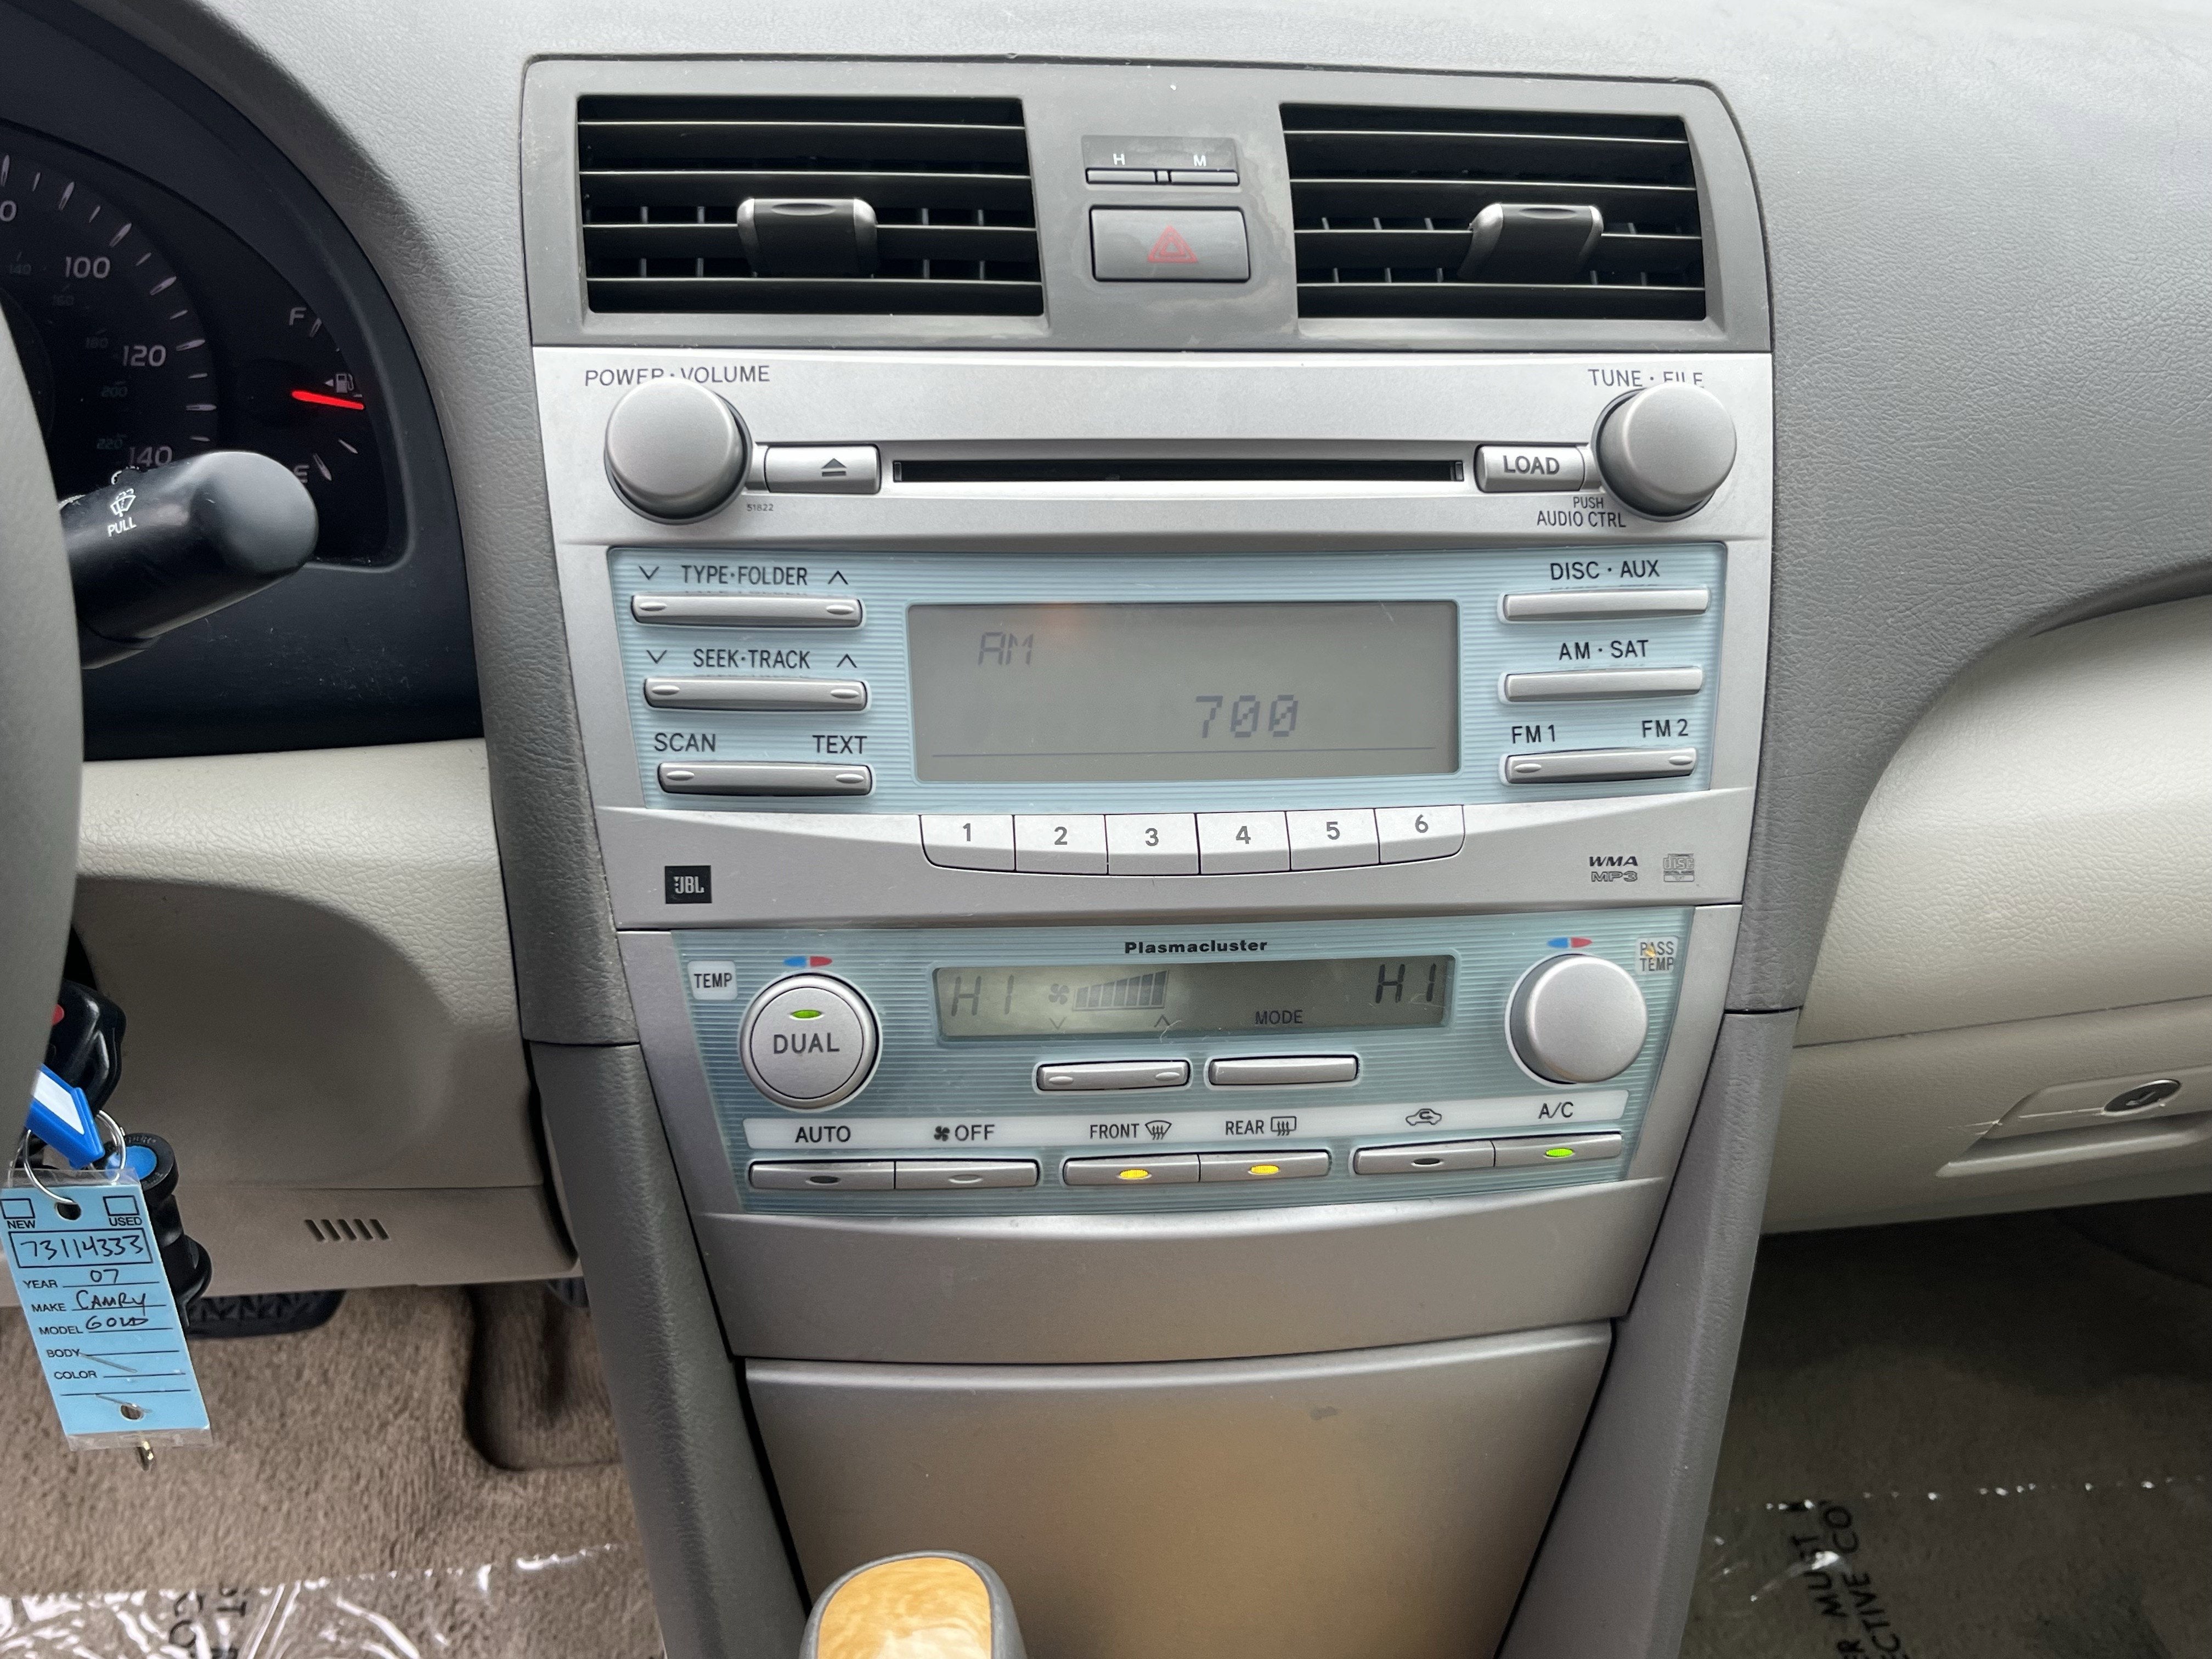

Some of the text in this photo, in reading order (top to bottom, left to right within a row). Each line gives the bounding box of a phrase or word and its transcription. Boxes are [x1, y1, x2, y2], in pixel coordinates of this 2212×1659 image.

[1113, 154, 1125, 165] H
[1193, 154, 1206, 166] M
[65, 256, 110, 278] 100
[289, 307, 307, 325] F
[122, 345, 167, 366] 120
[585, 365, 770, 386] POWER VOLUME
[1587, 369, 1643, 387] TUNE
[128, 446, 173, 467] 140
[1503, 454, 1560, 475] LOAD
[746, 503, 774, 512] 51822
[1572, 496, 1604, 509] PUSH
[108, 517, 137, 537] PULL
[1537, 511, 1627, 528] AUDIO CTRL
[1550, 560, 1661, 580] DISC AUX
[977, 631, 1035, 667] AM
[1558, 639, 1649, 661] AM SAT
[1194, 694, 1299, 738] 700
[654, 732, 716, 753] SCAN
[812, 734, 868, 754] TEXT
[963, 822, 972, 843] 1
[1326, 820, 1341, 840] 5
[1414, 814, 1429, 833] 6
[1053, 826, 1069, 846] 2
[1145, 827, 1160, 847] 3
[1235, 825, 1252, 845] 4
[1589, 856, 1638, 867] WMA
[673, 876, 705, 894] JBL
[1591, 870, 1638, 882] MP3
[1124, 939, 1268, 955] Plasmacluster
[1639, 956, 1675, 972] TEMP
[693, 972, 733, 989] TEMP
[1255, 1009, 1304, 1025] MODE
[773, 1032, 840, 1054] DUAL
[1538, 1101, 1575, 1119] A/C
[794, 1125, 852, 1143] AUTO
[955, 1124, 996, 1142] OFF
[1090, 1122, 1140, 1141] FRONT
[1225, 1119, 1265, 1136] REAR
[7, 1220, 36, 1229] NEW
[109, 1216, 143, 1227] USED
[20, 1234, 144, 1261] 73114333
[22, 1279, 59, 1289] YEAR
[89, 1268, 119, 1284] 07
[31, 1302, 67, 1313] MAKE
[38, 1325, 84, 1335] MODEL
[46, 1348, 81, 1358] BODY
[54, 1370, 98, 1380] COLOR
